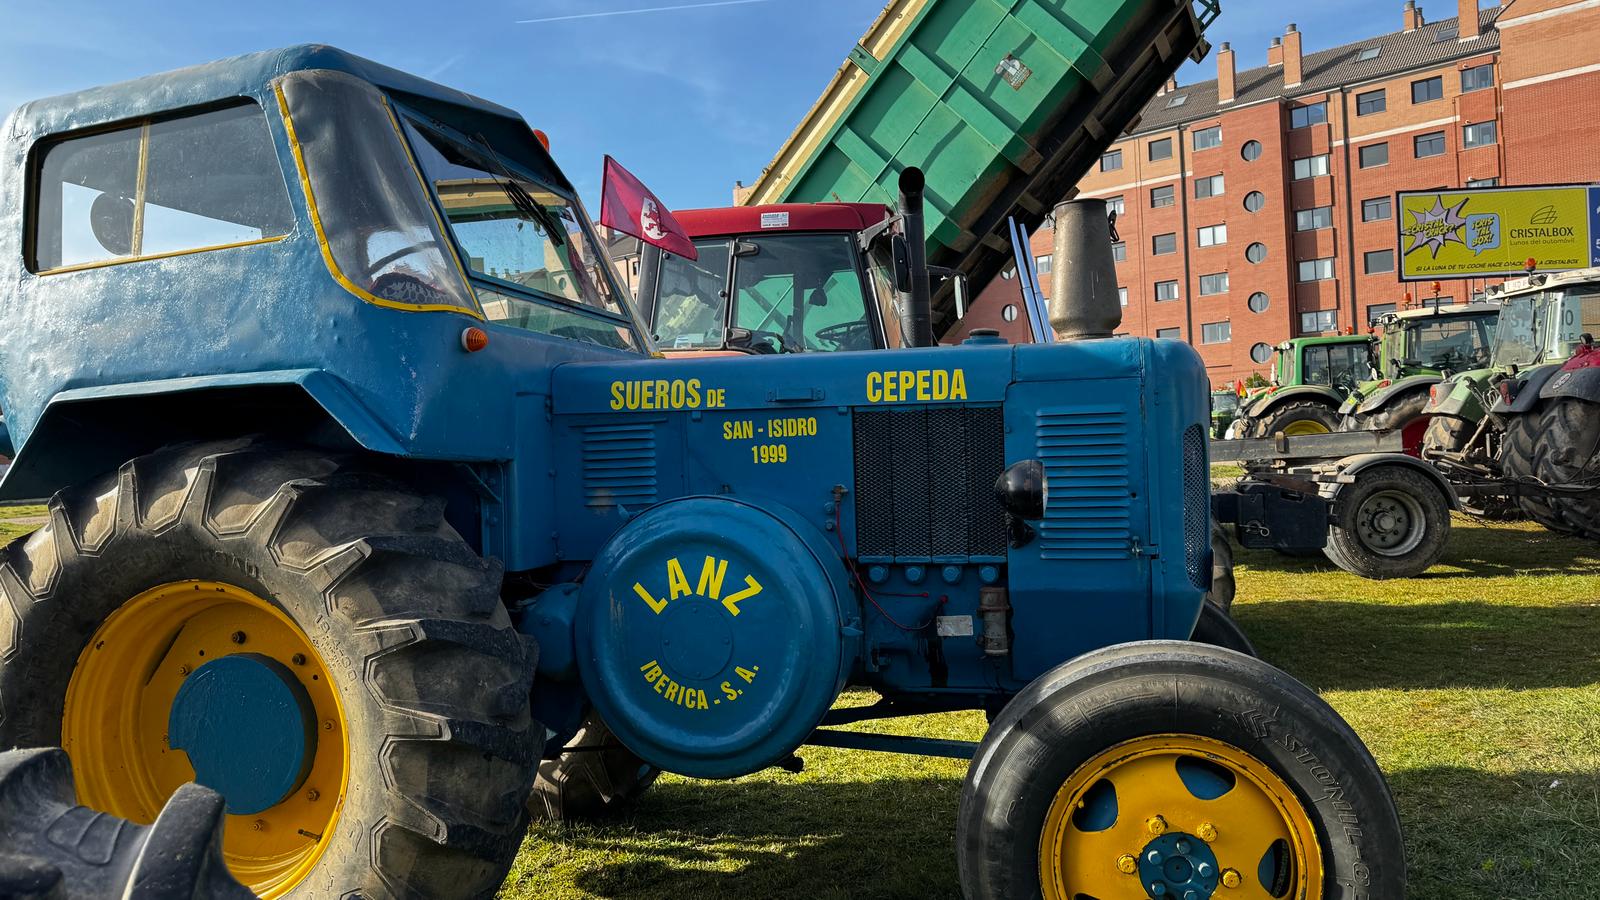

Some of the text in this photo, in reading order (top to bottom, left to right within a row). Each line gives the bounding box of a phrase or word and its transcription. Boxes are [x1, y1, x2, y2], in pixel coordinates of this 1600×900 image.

[1510, 227, 1574, 238] CRISTALBOX
[610, 369, 968, 409] SUEROS DE CEPEDA
[723, 420, 754, 440] SAN
[768, 417, 817, 438] ISIDRO
[751, 445, 788, 464] 1999
[633, 555, 763, 617] LANZ
[640, 660, 709, 710] IBERICA
